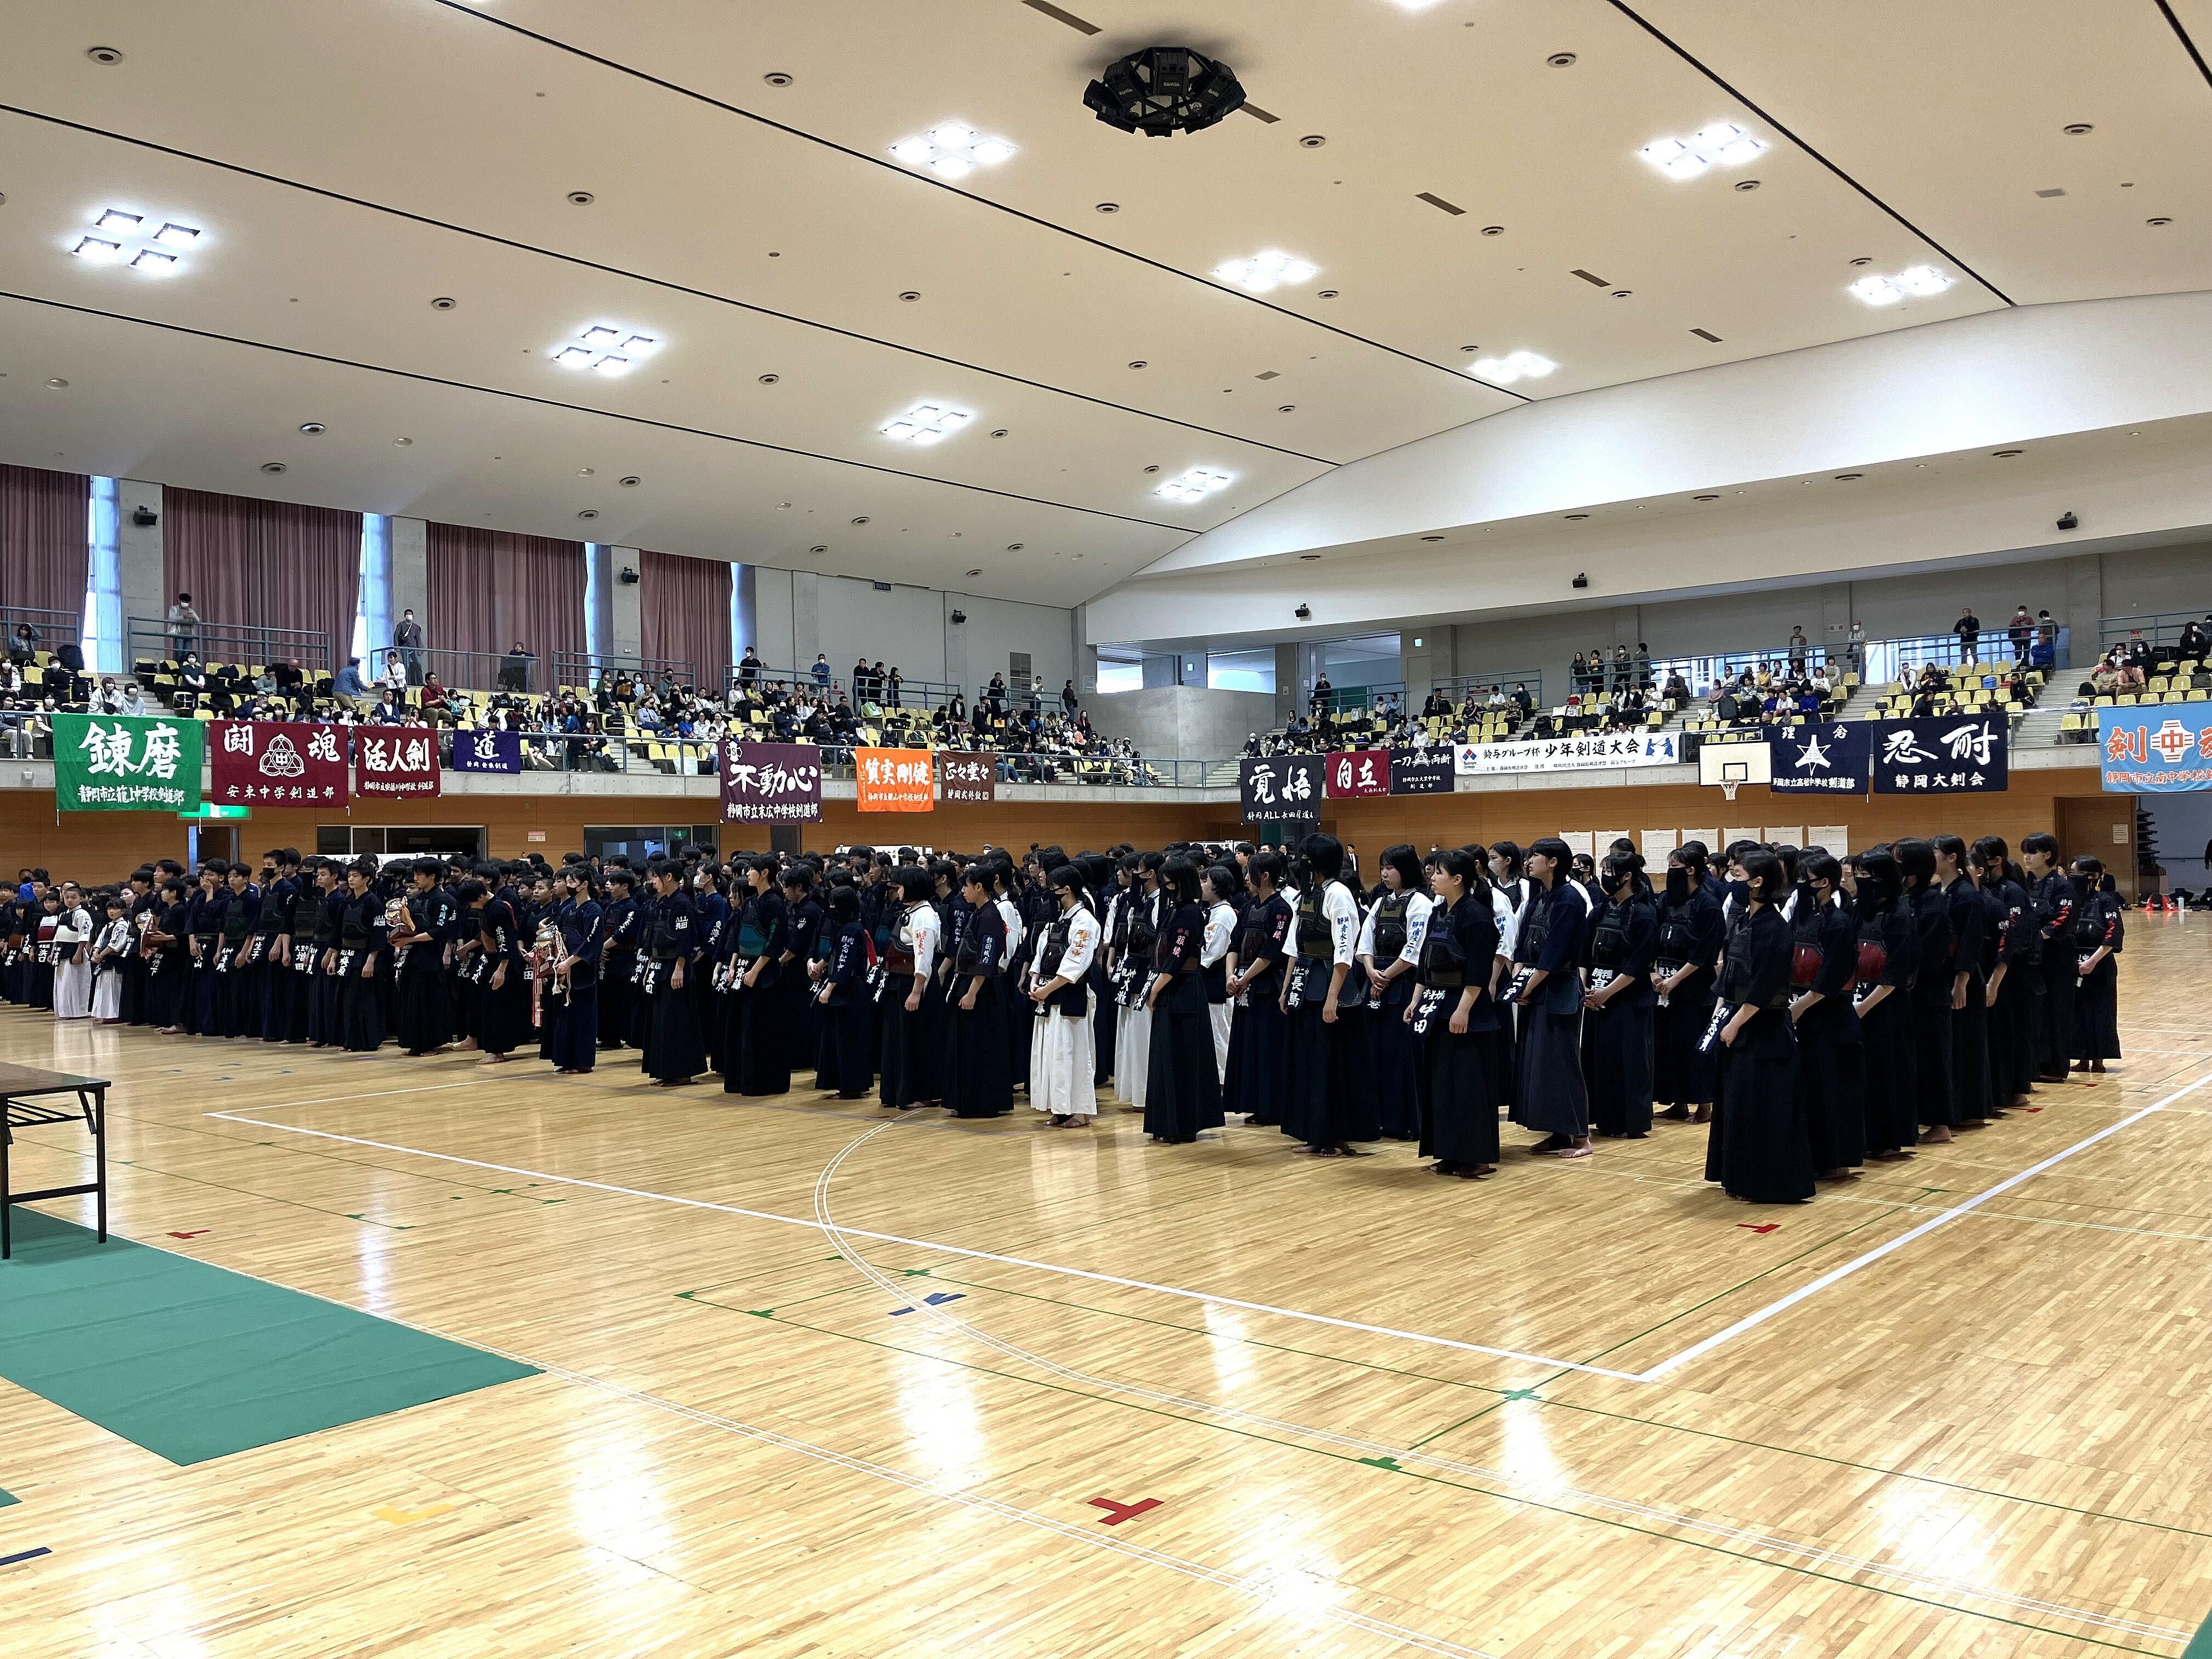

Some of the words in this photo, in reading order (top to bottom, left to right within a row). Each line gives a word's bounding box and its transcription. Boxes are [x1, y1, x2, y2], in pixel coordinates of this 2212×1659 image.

[307, 725, 341, 762] 魂
[473, 730, 500, 759] 道
[1483, 747, 1541, 759] 鈴与グループ杯
[1544, 737, 1640, 759] 少年剣道大会
[1781, 725, 1796, 740] 理
[1832, 724, 1848, 739] 念
[1882, 720, 1999, 766] 忍耐
[363, 737, 430, 772] 活人剣
[1392, 756, 1412, 767] 一刀
[1431, 753, 1452, 765] 両断
[727, 760, 818, 798] 不動心
[865, 757, 931, 786] 質実剛健
[1249, 764, 1312, 804] 覚悟
[1337, 757, 1378, 789] 自立
[1263, 810, 1280, 820] ALL
[1288, 976, 1304, 1008] 長島
